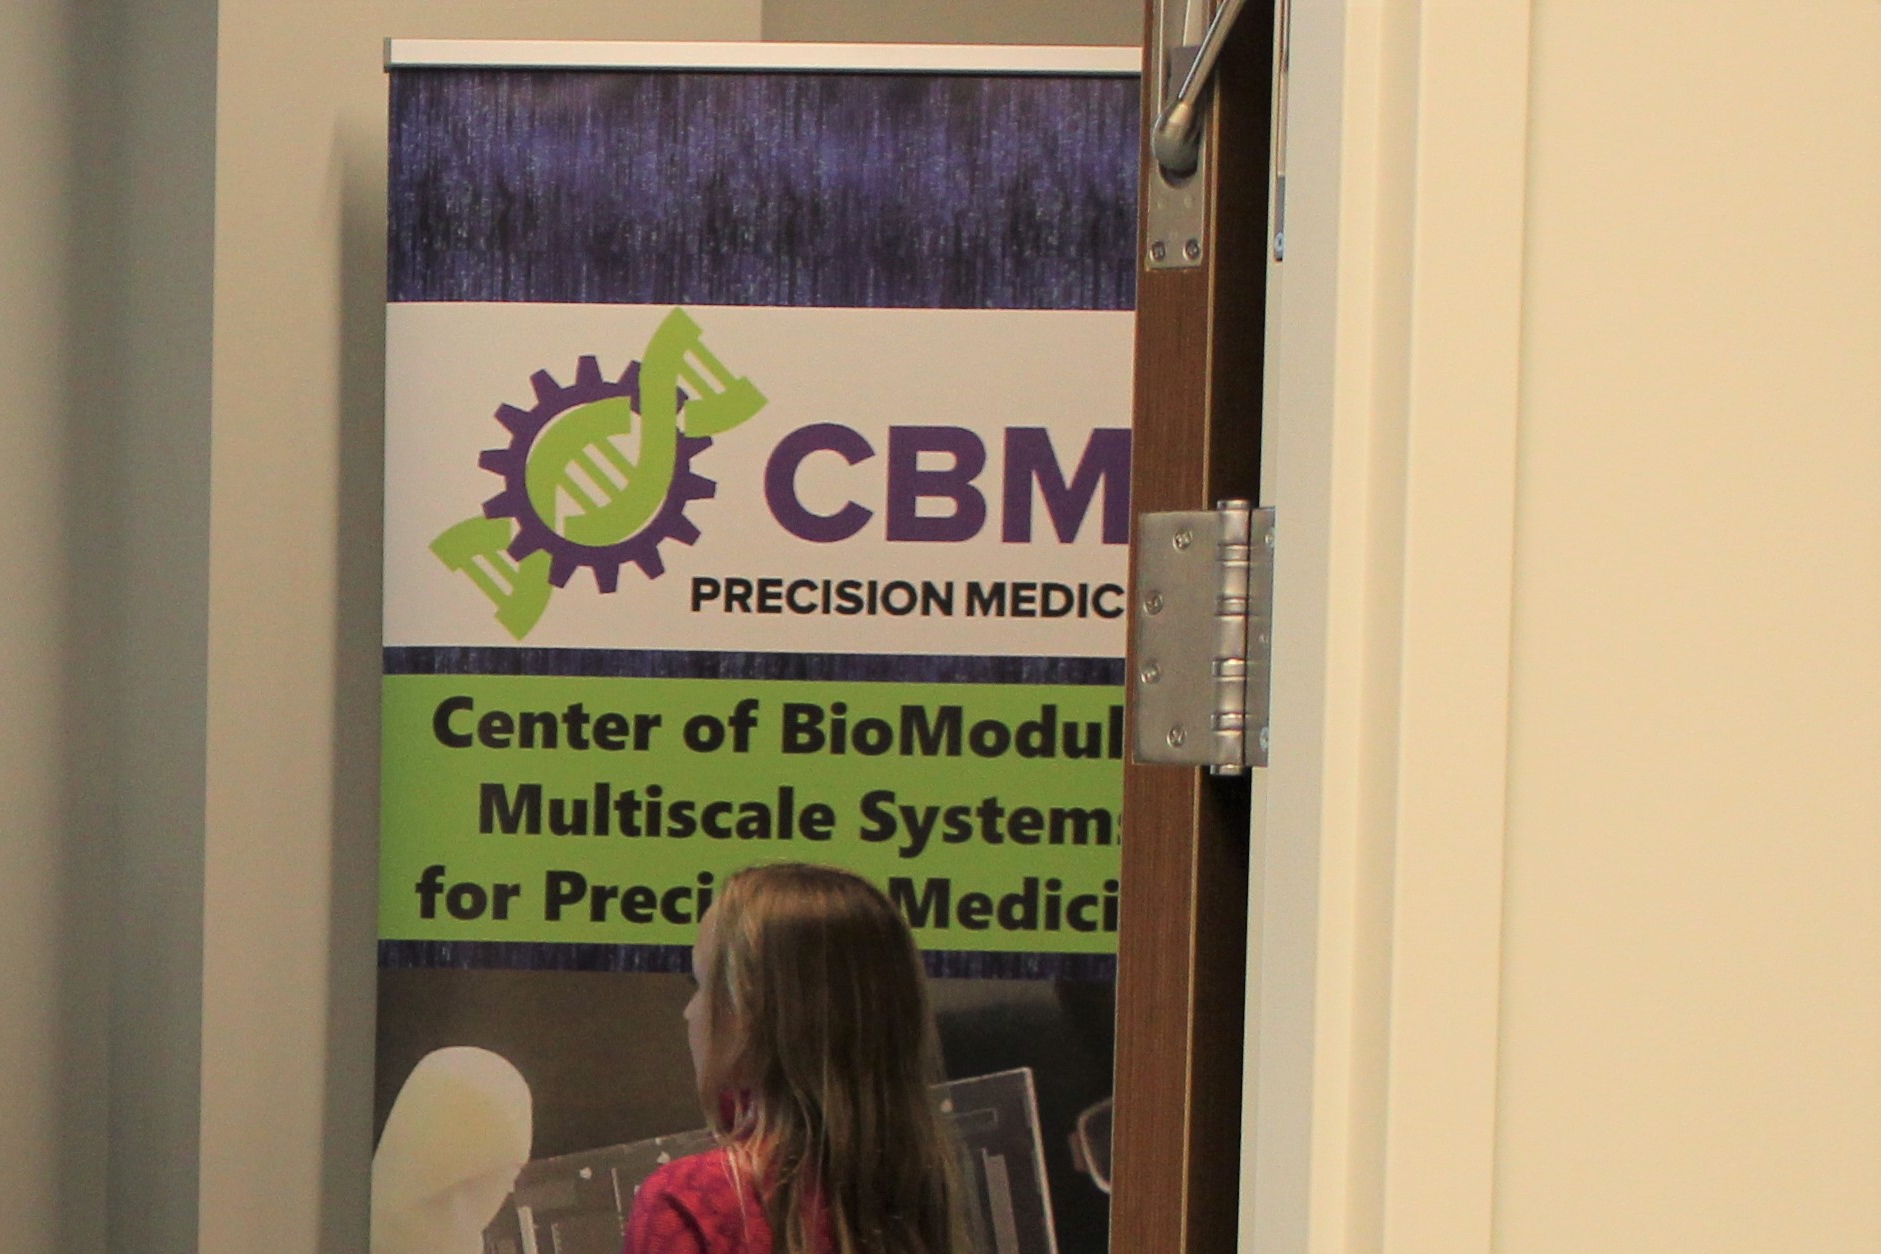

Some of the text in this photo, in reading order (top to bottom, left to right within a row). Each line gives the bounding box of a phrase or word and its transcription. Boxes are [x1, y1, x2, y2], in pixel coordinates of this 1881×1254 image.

[764, 423, 1131, 544] CBM
[691, 577, 1125, 619] PRECISION MEDIC
[432, 695, 1123, 760] Center of BioModul
[479, 782, 1121, 858] Multiscale System
[415, 864, 520, 921] for
[888, 876, 1119, 932] Medici
